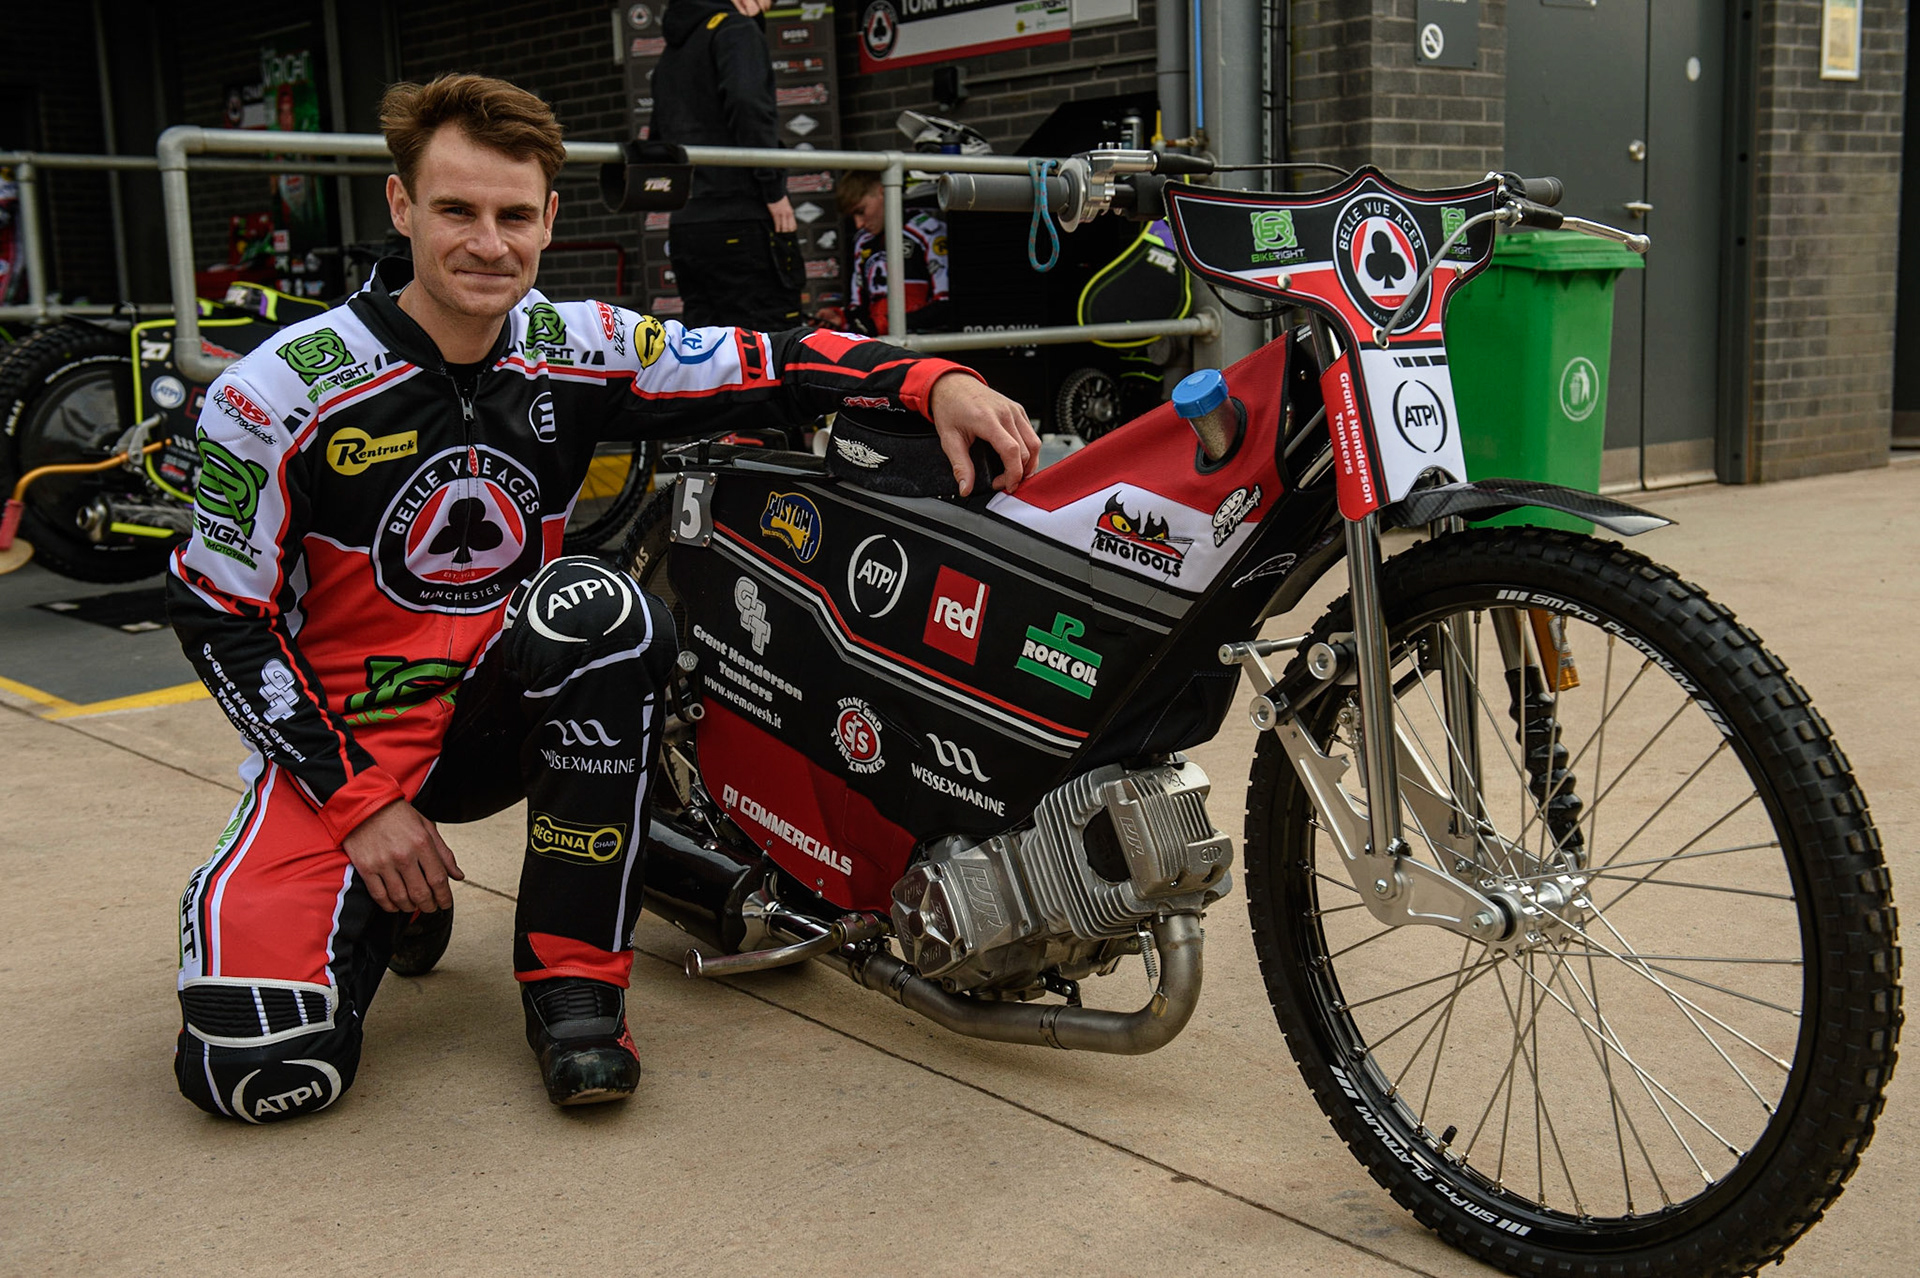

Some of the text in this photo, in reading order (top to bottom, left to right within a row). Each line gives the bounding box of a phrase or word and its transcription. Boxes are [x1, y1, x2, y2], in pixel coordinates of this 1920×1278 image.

[1338, 201, 1422, 251] BELLE VUE ACES
[1251, 248, 1306, 263] BIKERIGHT
[307, 362, 368, 403] BIKERIGHT
[1339, 372, 1373, 504] Grant Henderson
[1405, 404, 1438, 428] ATPI
[333, 438, 415, 466] Rentruck
[1334, 412, 1354, 475] Tankers
[389, 470, 441, 535] BELLE
[448, 457, 492, 475] VE
[496, 468, 540, 515] ACES
[679, 478, 705, 539] 5
[769, 494, 814, 535] CUSTOM
[419, 583, 502, 601] MANCHESTER
[547, 578, 616, 620] ATPI
[857, 558, 898, 594] ATPI
[933, 582, 986, 640] red
[203, 642, 237, 691] Grant
[693, 624, 803, 702] Grant Henderson
[1021, 639, 1098, 687] ROCK OIL
[1602, 620, 1699, 693] PLATINUM
[704, 675, 782, 730] www.wemovesh.it
[718, 660, 774, 703] Tankers
[911, 762, 1006, 817] WESSEXMARINE
[533, 823, 617, 851] REGINA CHAIN
[739, 803, 853, 884] COMMERCIALS
[254, 1080, 324, 1117] ATPI
[1354, 1105, 1434, 1182] PLATINUM
